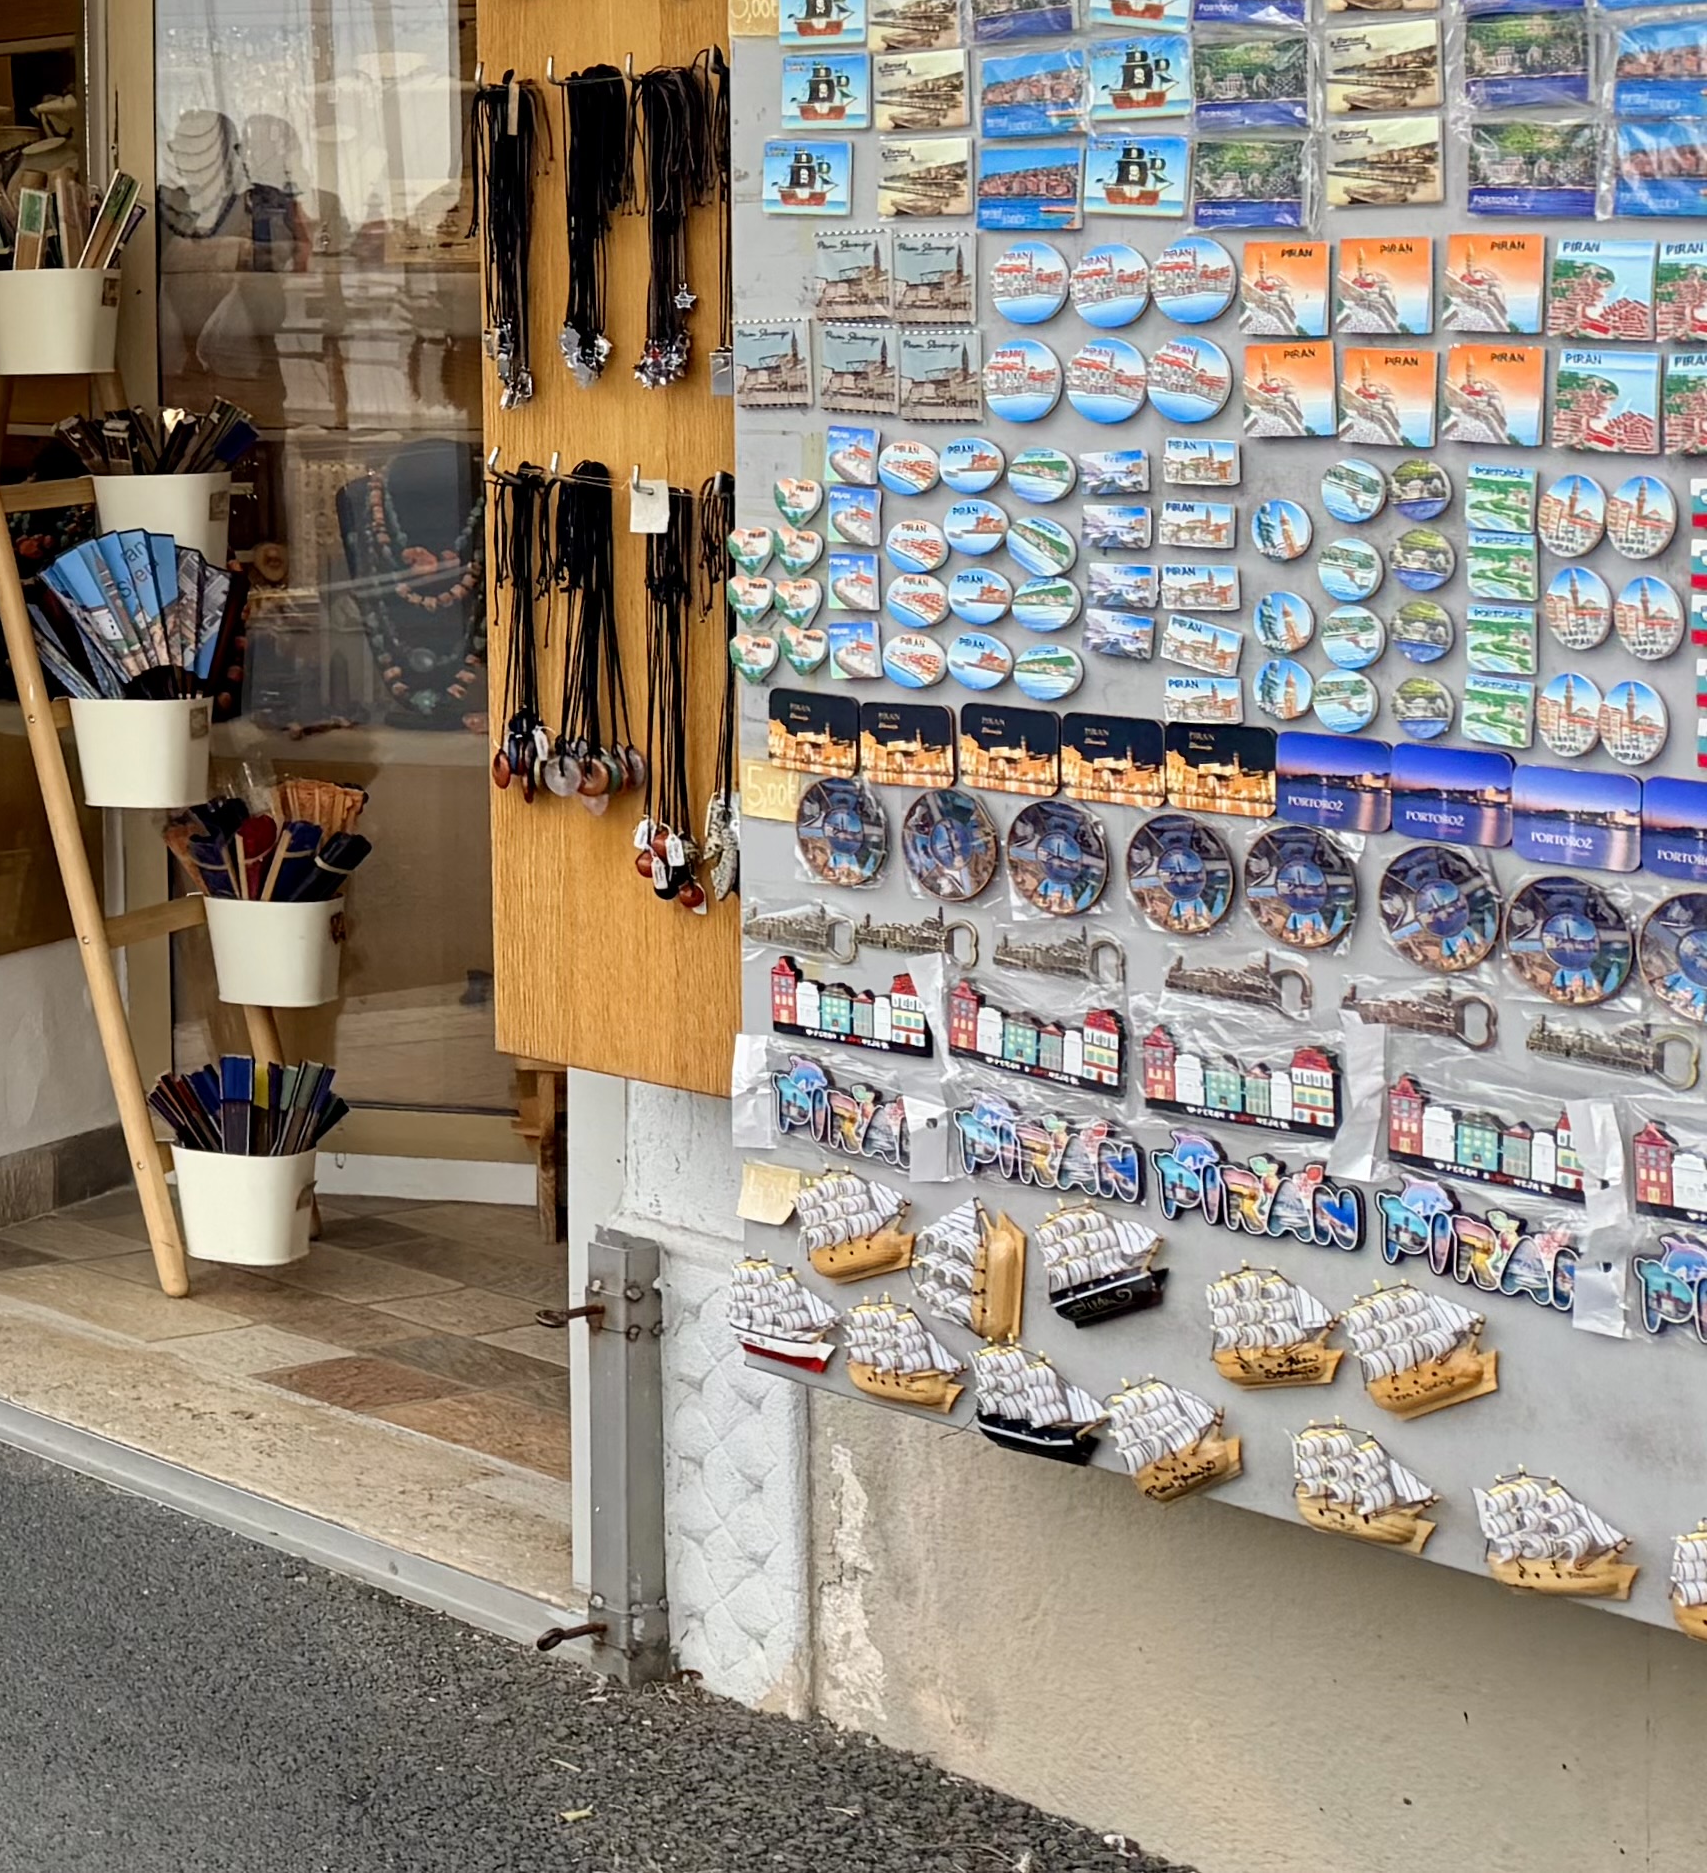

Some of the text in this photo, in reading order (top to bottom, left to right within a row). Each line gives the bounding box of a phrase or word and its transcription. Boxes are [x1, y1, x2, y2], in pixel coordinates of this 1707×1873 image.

[1563, 241, 1601, 253] PIRAN
[1665, 242, 1704, 255] PIRAN
[1565, 354, 1601, 365] PIRAN
[746, 767, 799, 808] 5,00€
[1288, 795, 1344, 812] PORTOROŽ
[1405, 810, 1466, 827] PORTOROŽ
[1530, 831, 1594, 850] PORTOROŽ
[771, 1070, 911, 1169] PIRA
[954, 1108, 1146, 1204] PIRAN
[1151, 1149, 1366, 1251] PIRAN
